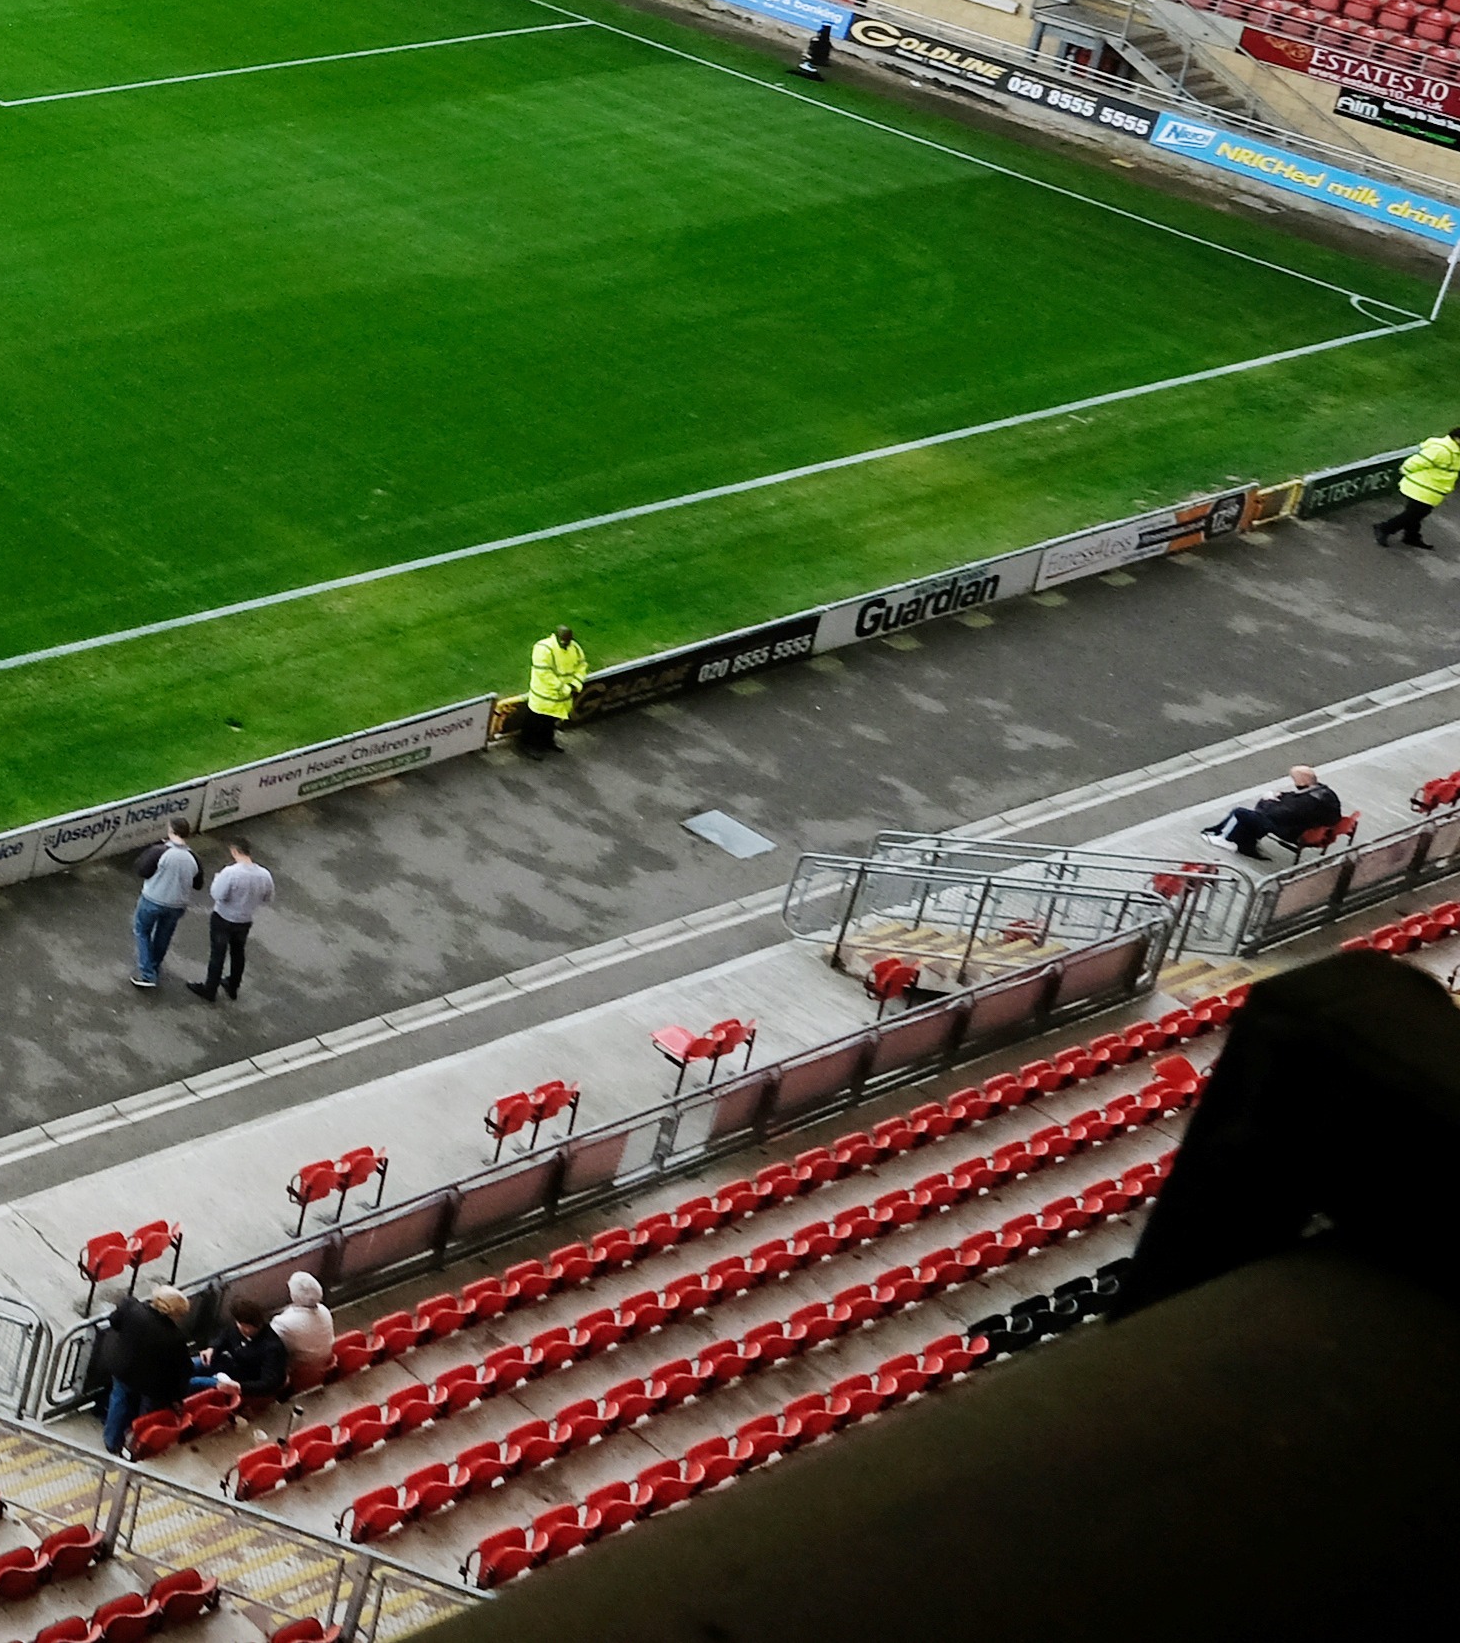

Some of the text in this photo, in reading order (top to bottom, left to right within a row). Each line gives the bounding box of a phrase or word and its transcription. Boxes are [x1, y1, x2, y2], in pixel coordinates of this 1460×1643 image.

[850, 19, 1008, 80] GOLDLINE
[1008, 75, 1041, 100] 020
[1047, 87, 1097, 119] 8555
[1099, 102, 1151, 135] 5555
[1309, 46, 1450, 103] ESTATES 10
[1327, 180, 1381, 210] milk
[1387, 200, 1456, 236] drink
[855, 573, 1001, 638] Guardian
[698, 633, 813, 683] 020 8555 5555
[258, 715, 474, 788] Haven House Children's Hospice
[125, 795, 190, 828] hospice
